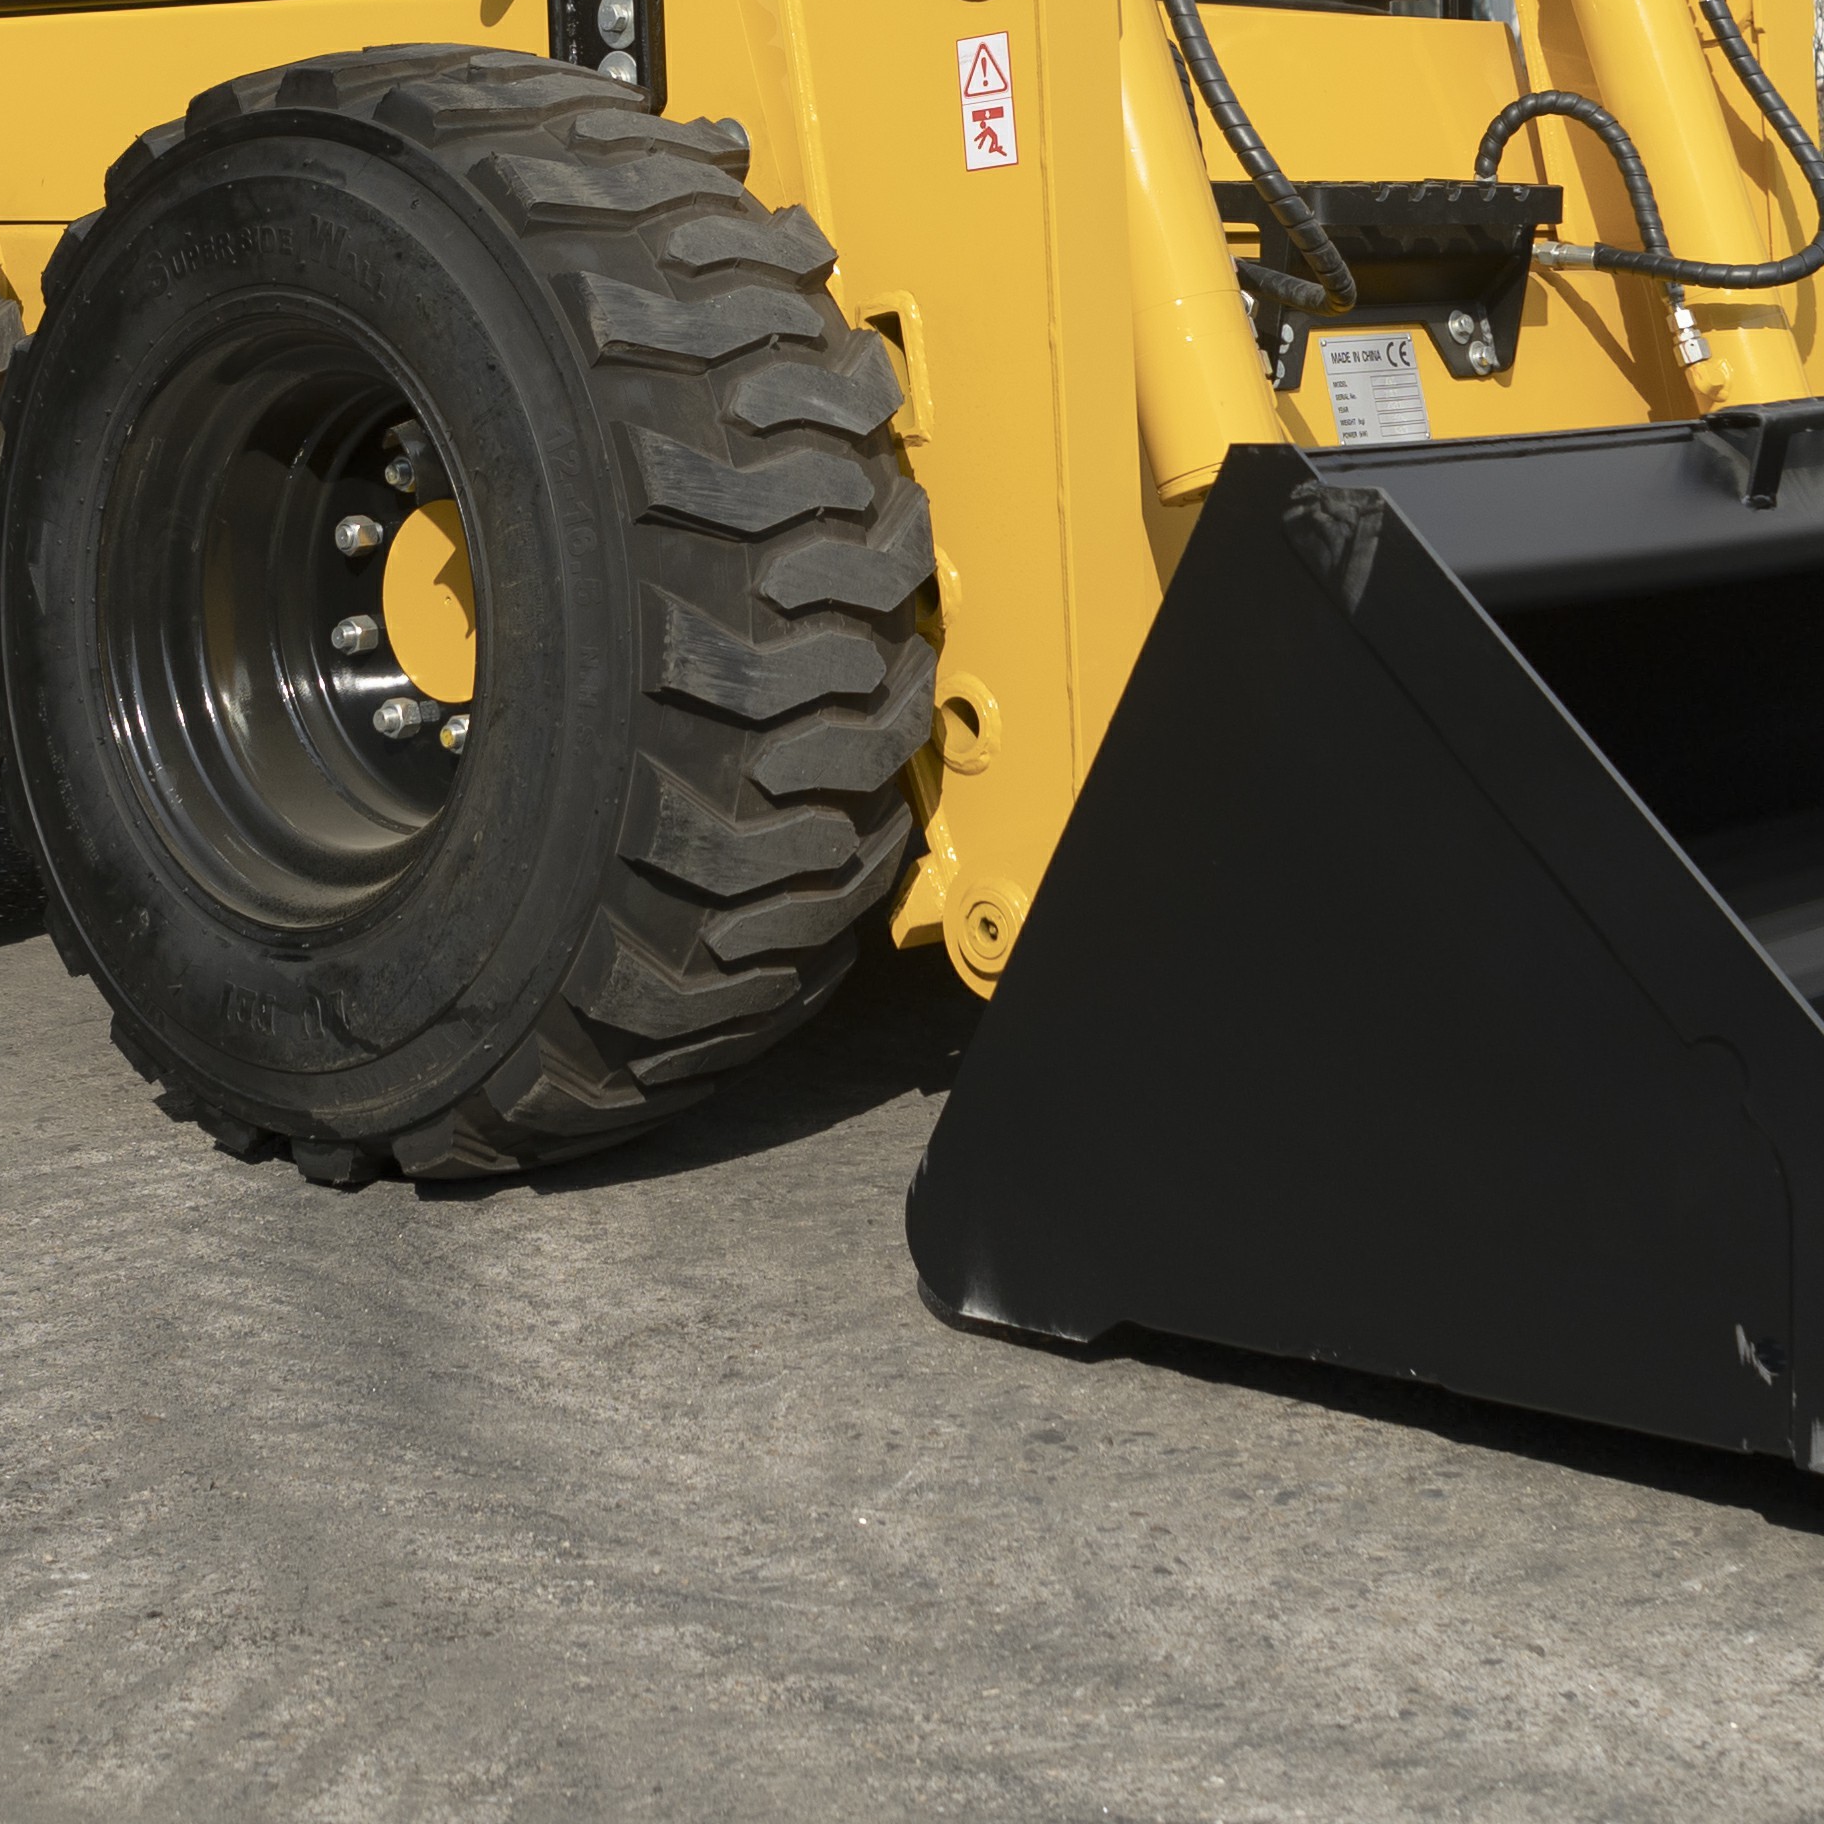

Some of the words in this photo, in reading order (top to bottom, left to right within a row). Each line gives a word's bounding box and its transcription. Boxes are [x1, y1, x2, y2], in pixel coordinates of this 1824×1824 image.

[1330, 352, 1351, 364] MADE
[1353, 351, 1360, 363] IN
[1362, 350, 1382, 363] CHINA
[1386, 341, 1410, 367] CE
[1340, 418, 1356, 426] WEIGHT
[1342, 431, 1357, 439] POWER
[544, 424, 603, 607] 12-16.5
